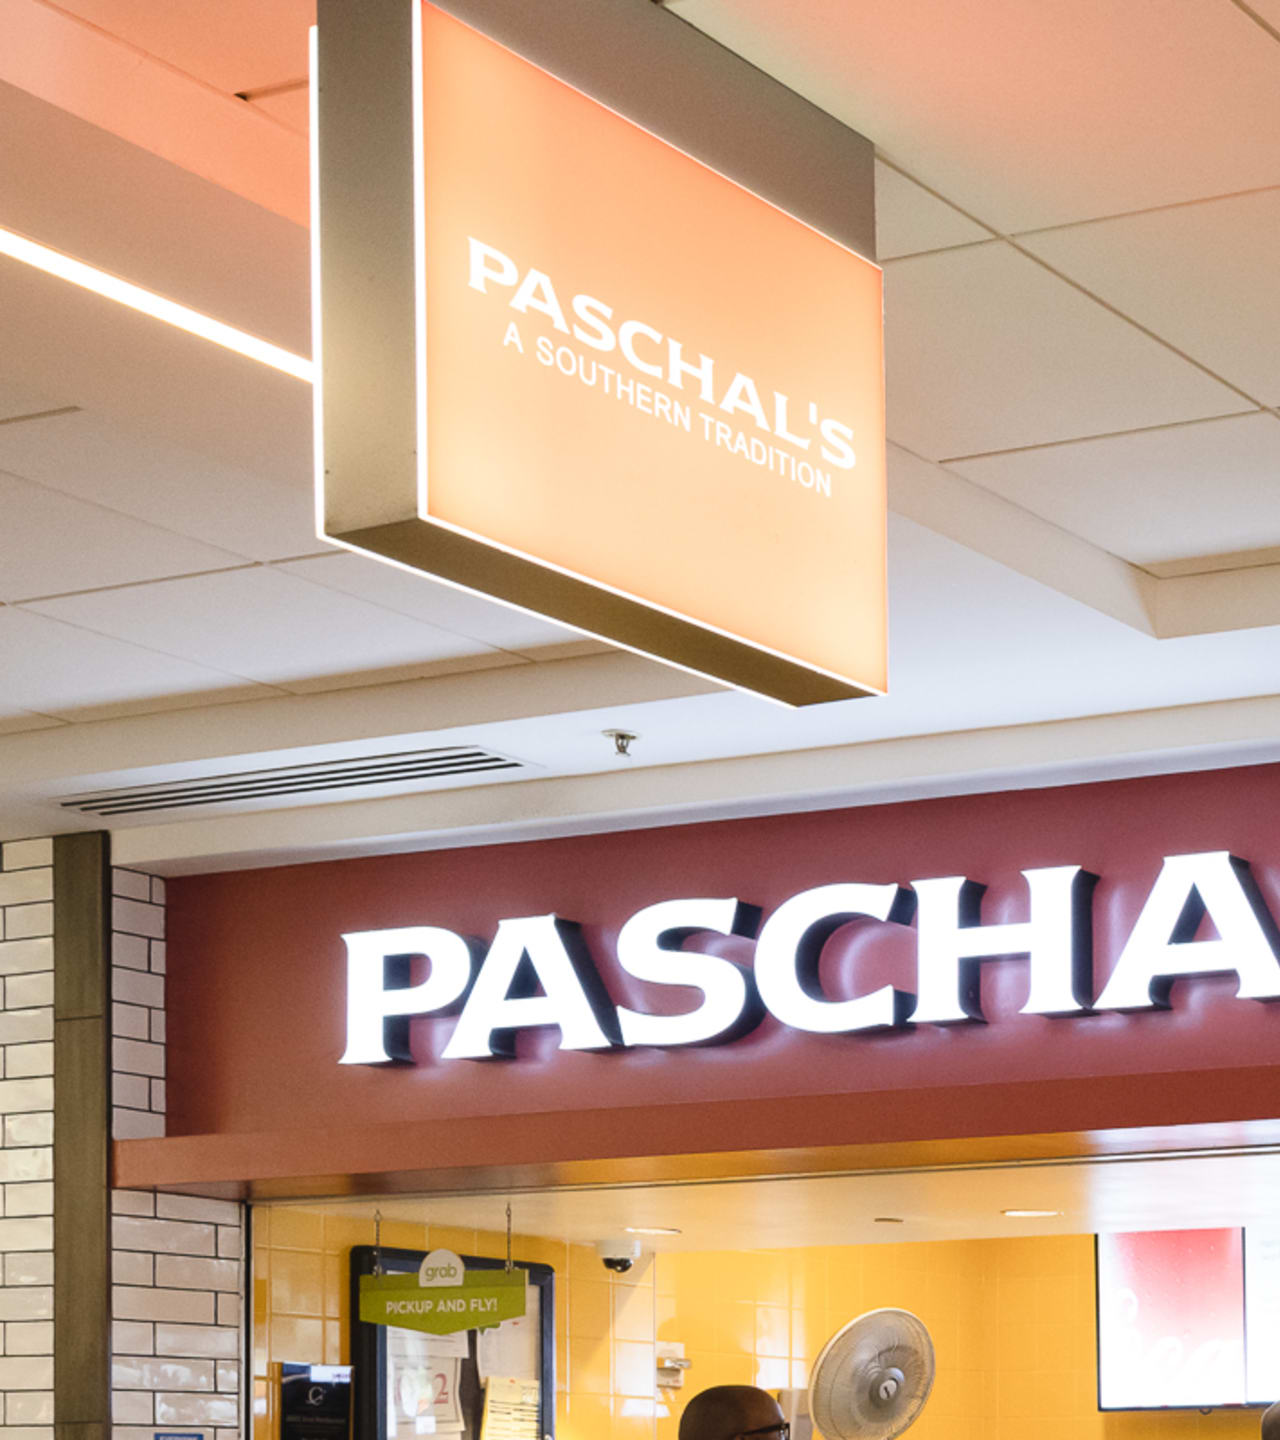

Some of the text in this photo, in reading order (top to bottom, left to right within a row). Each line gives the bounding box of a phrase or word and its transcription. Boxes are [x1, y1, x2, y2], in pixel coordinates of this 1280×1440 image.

[467, 236, 856, 470] PASCHAL'S
[503, 323, 832, 497] A SOUTHERN TRADITION
[386, 1298, 498, 1315] PICKUP AND FLY!
[424, 1263, 458, 1282] grab
